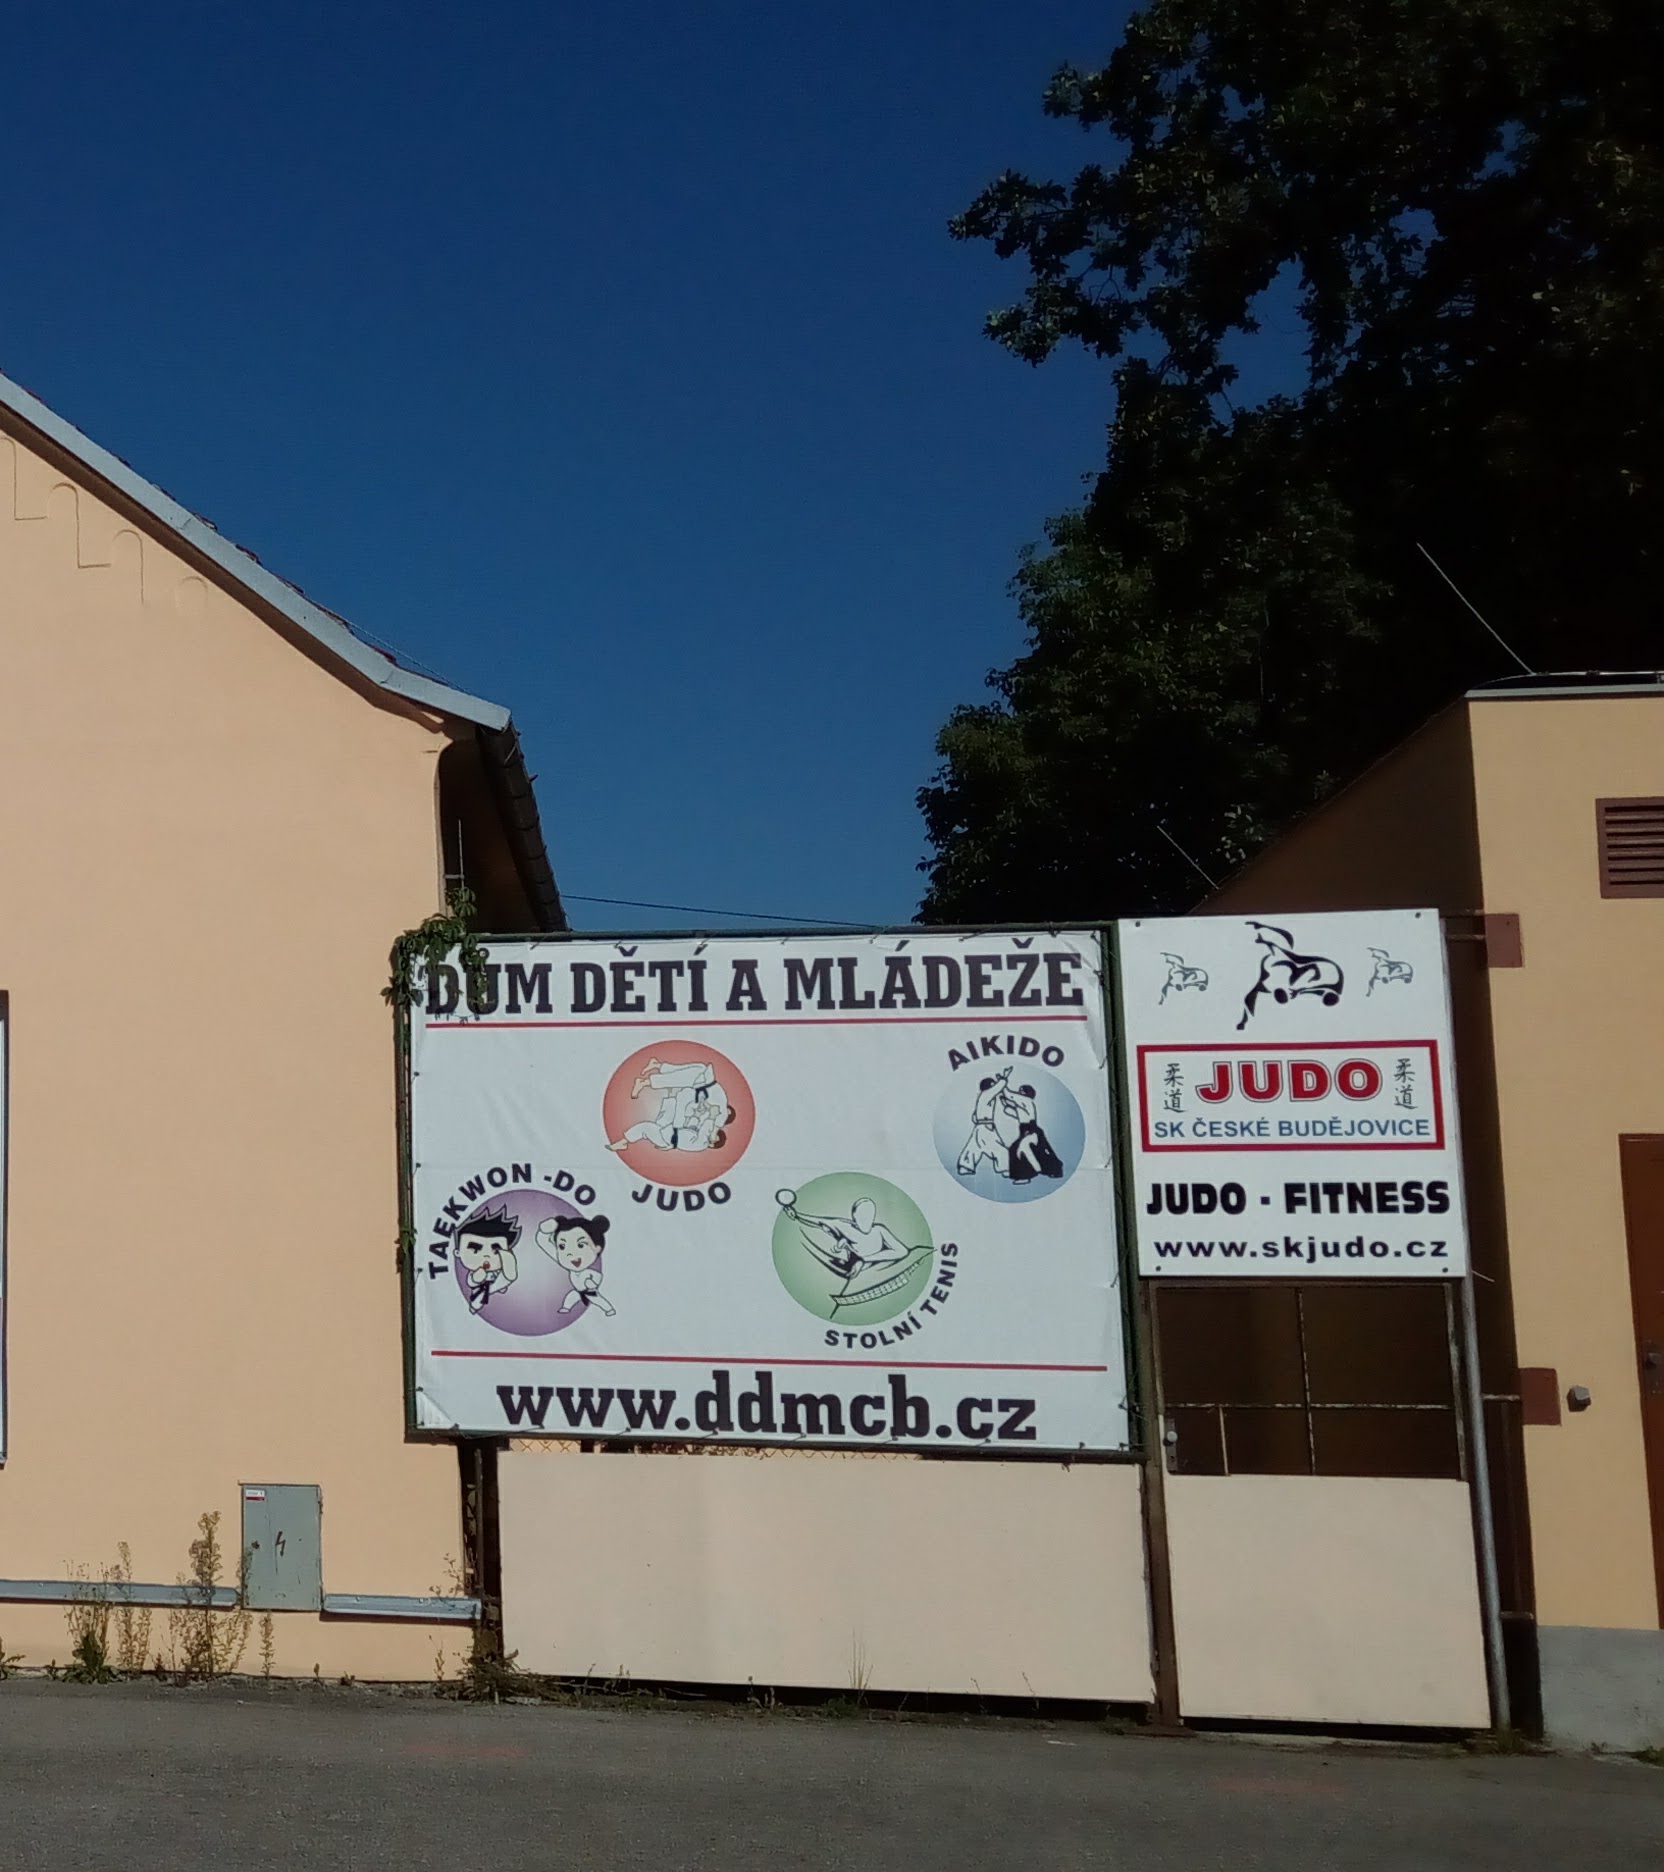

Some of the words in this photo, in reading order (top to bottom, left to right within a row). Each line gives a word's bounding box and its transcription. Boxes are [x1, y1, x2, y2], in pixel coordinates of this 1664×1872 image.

[570, 944, 710, 1013] DĚTÍ
[726, 959, 768, 1012] A
[783, 937, 1084, 1010] MLÁDEŽE
[946, 1034, 1066, 1071] AIKIDO
[1195, 1057, 1383, 1104] JUDO
[1154, 1121, 1184, 1138] SK
[1192, 1117, 1271, 1138] ČESKÉ
[1278, 1115, 1431, 1137] BUDĚJOVICE
[631, 1182, 733, 1213] JUDO
[1146, 1183, 1246, 1215] JUDO
[1284, 1180, 1450, 1215] FITNESS
[428, 1162, 534, 1280] TAEKWON
[1154, 1236, 1449, 1264] www.skjudo.cz
[824, 1312, 921, 1350] STOLNÍ
[921, 1241, 959, 1317] TENIS
[496, 1369, 1037, 1441] www.ddmcb.cz
